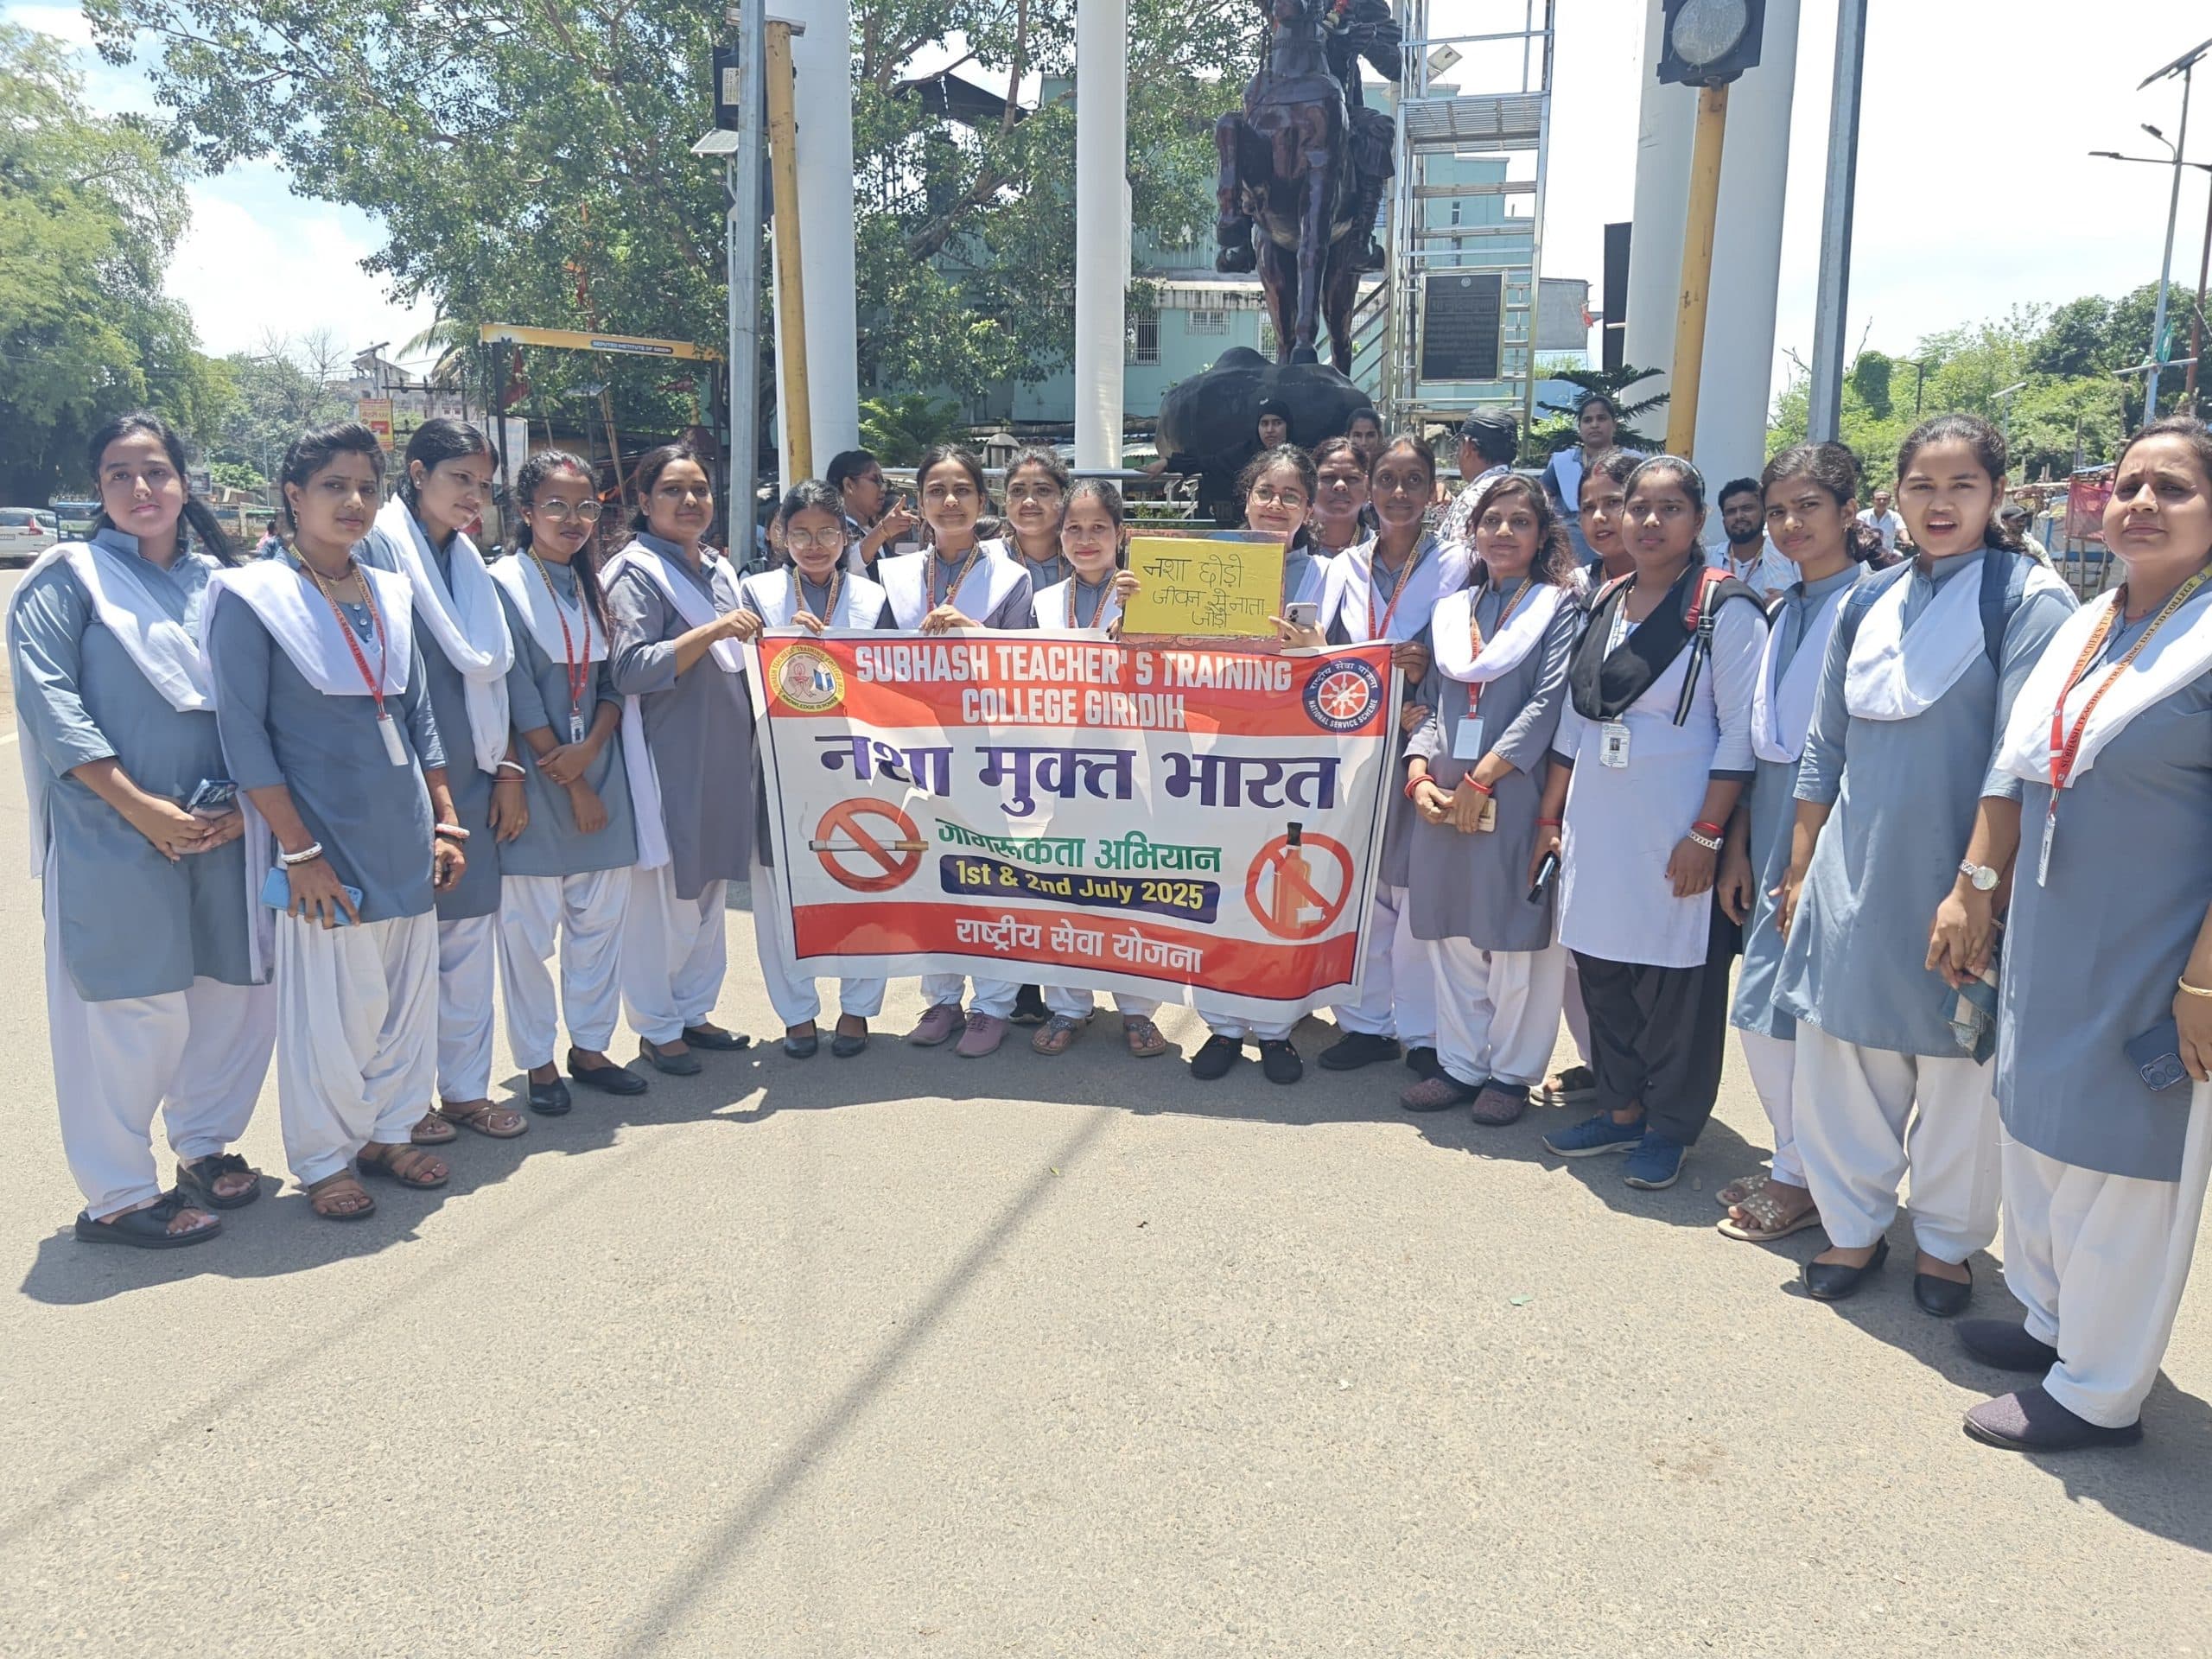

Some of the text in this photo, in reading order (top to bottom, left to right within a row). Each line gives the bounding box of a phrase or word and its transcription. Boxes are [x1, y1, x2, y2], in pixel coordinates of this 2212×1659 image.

[1143, 557, 1192, 582] नशा
[1153, 586, 1206, 607] जीवन
[855, 645, 988, 682] SUBHASH
[1160, 652, 1292, 691] TRAINING
[2061, 726, 2082, 768] SUBHASH
[2078, 682, 2109, 725] TEACHER'S
[2108, 639, 2143, 682] TRAINING
[2164, 581, 2197, 616] COLLEGE
[962, 689, 1184, 728] COLLEGE GIRIDIH
[1308, 698, 1378, 729] NATIONAL SERVICE SCHEME
[815, 734, 1342, 817] नशा मुक्त भारत
[1094, 830, 1222, 873] अभियान
[956, 860, 1204, 910] 1st & 2nd July 2025
[956, 914, 1204, 974] राष्ट्रीय सेवा योजना
